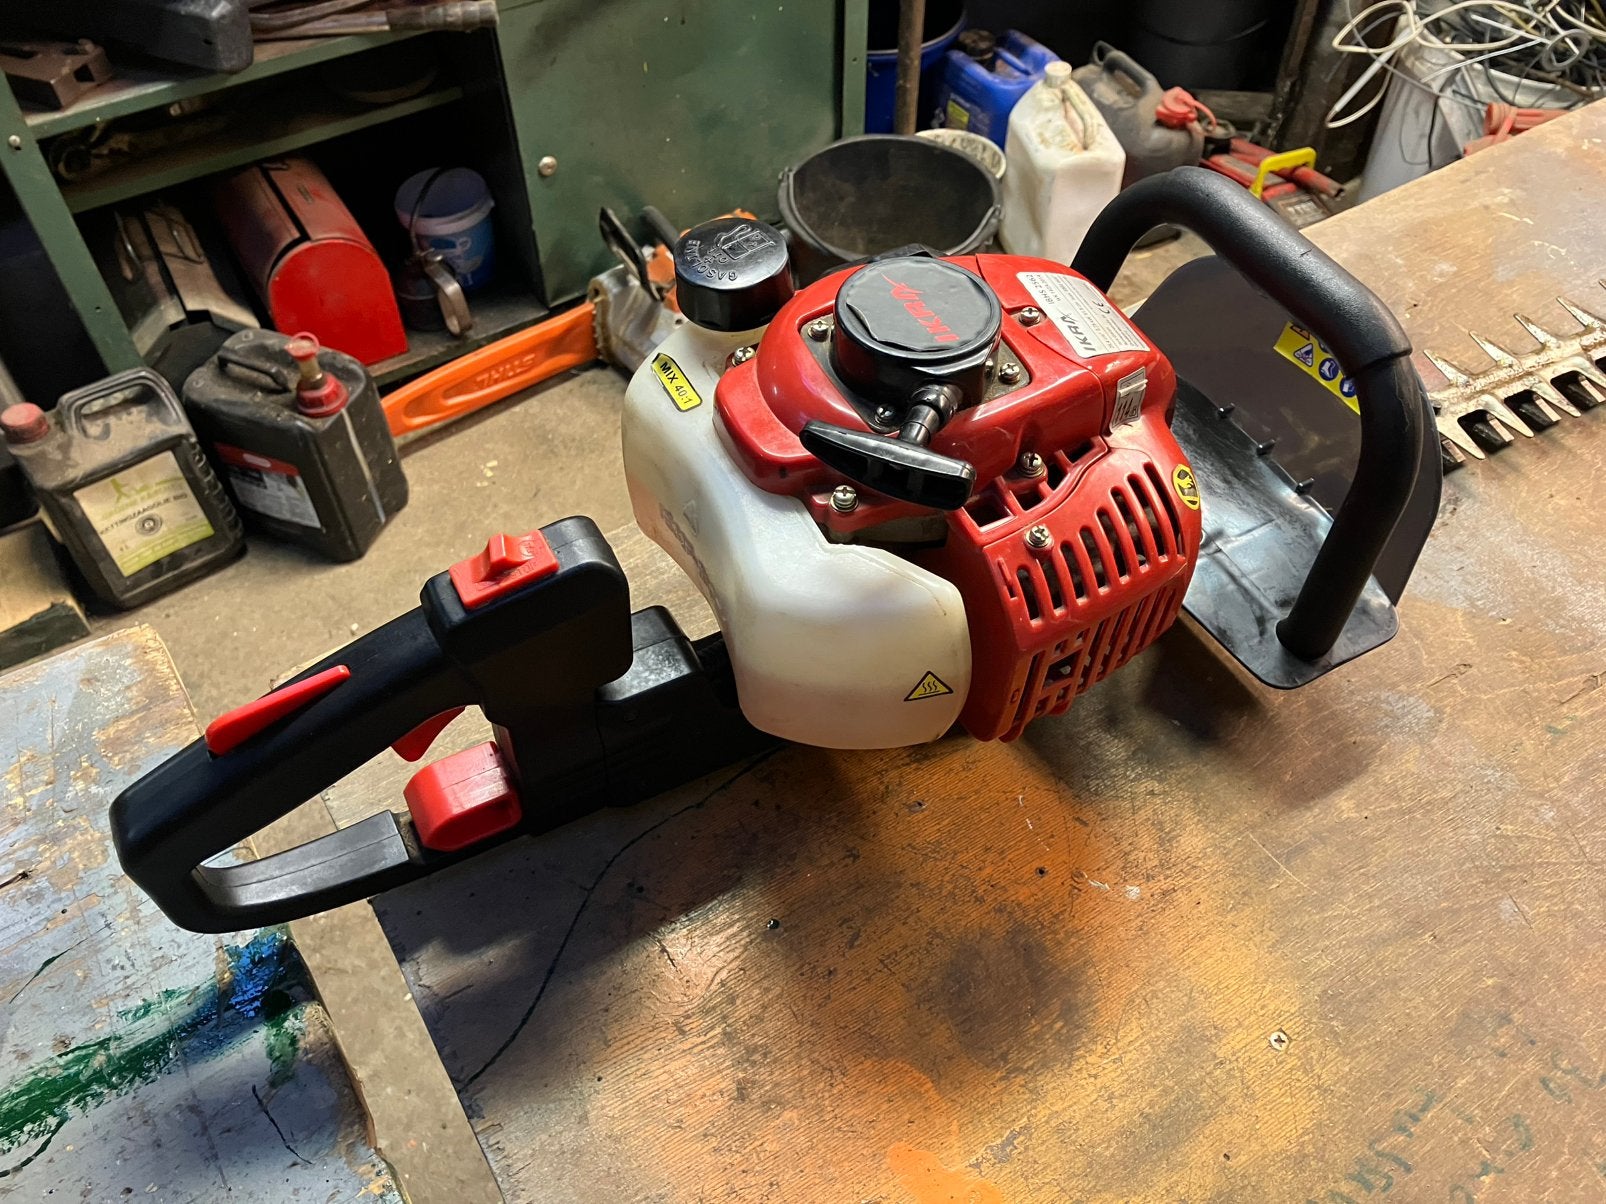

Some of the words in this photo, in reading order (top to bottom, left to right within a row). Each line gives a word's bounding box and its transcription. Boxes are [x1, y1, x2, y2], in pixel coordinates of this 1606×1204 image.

[685, 239, 738, 281] GASOLINE
[880, 272, 960, 343] IKRA
[1057, 307, 1097, 352] IKRA
[660, 361, 679, 384] MIX
[675, 385, 693, 404] 40:1
